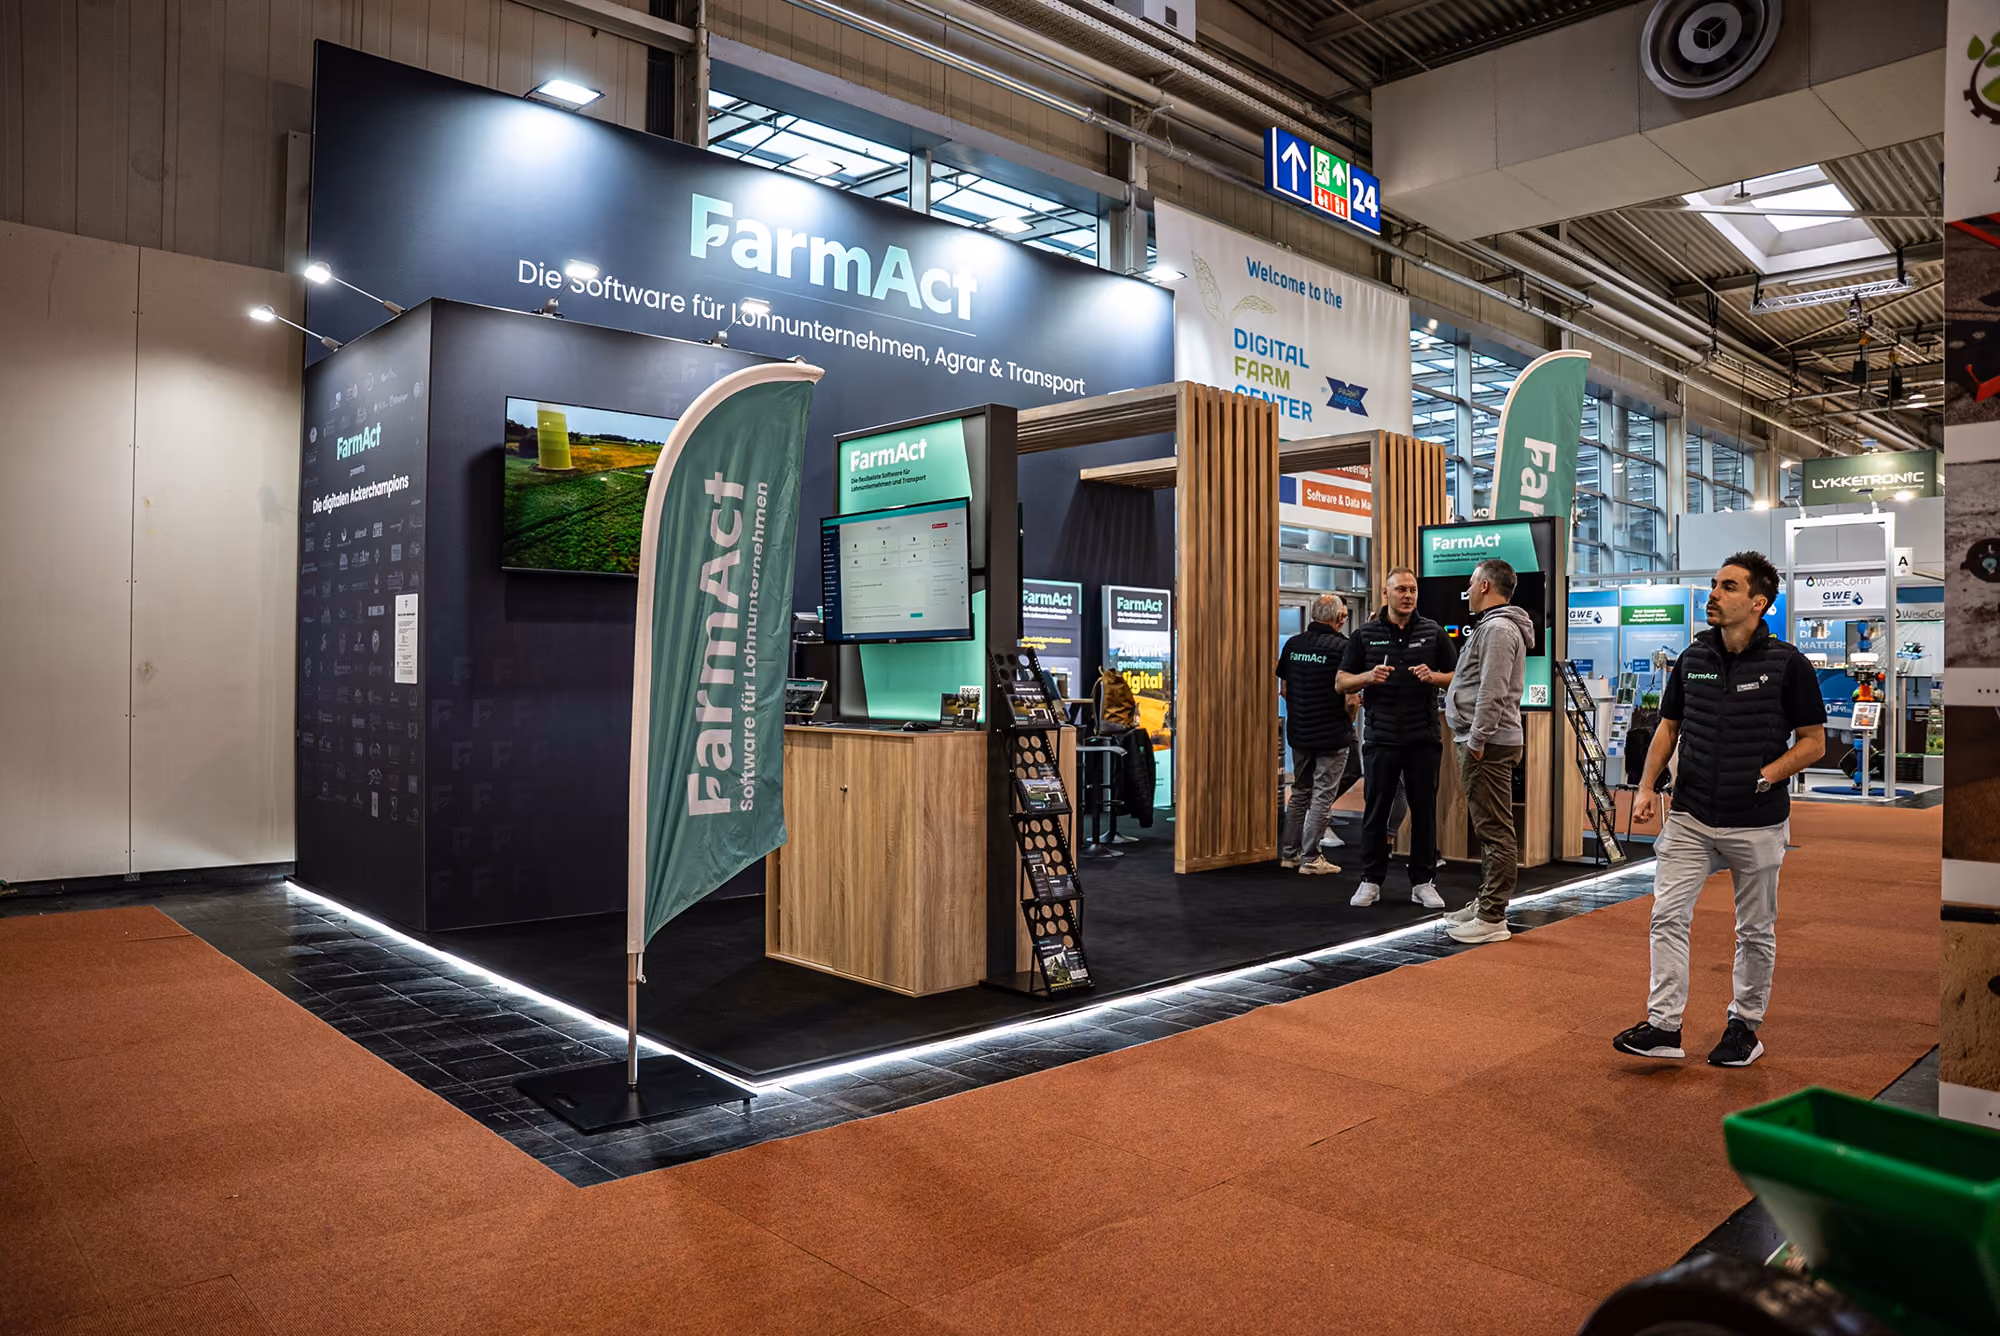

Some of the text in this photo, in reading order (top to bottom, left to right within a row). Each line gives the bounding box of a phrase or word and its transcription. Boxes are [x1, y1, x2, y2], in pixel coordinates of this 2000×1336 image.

[1352, 177, 1378, 219] 24
[691, 193, 977, 320] FarmAct
[1246, 256, 1342, 309] Welcome to the
[518, 259, 1085, 395] Die Software für Lohnunternehmen, Agrar & Transport
[1234, 327, 1310, 369] DIGITAL
[1234, 355, 1290, 391] FARM
[336, 421, 381, 461] FarmAct
[850, 438, 927, 472] FarmAct
[881, 470, 902, 478] Software
[892, 478, 902, 486] und
[902, 474, 927, 483] Transport
[312, 474, 409, 514] Die digitalen Ackerchampions
[1306, 488, 1372, 511] Software & Data Ma
[1432, 533, 1501, 551] FarmAct
[1898, 556, 1909, 567] A
[1815, 576, 1871, 587] WiseConn
[1023, 590, 1073, 607] FarmAct
[1117, 596, 1163, 612] FarmAct
[1822, 591, 1852, 600] GWE
[1569, 610, 1593, 619] GWE
[687, 471, 744, 816] FarmAct
[740, 481, 768, 812] Software für Lohnunternehmen
[1117, 659, 1163, 671] gemeinsam
[1290, 652, 1327, 664] FarmAct
[1687, 672, 1718, 680] FarmAct
